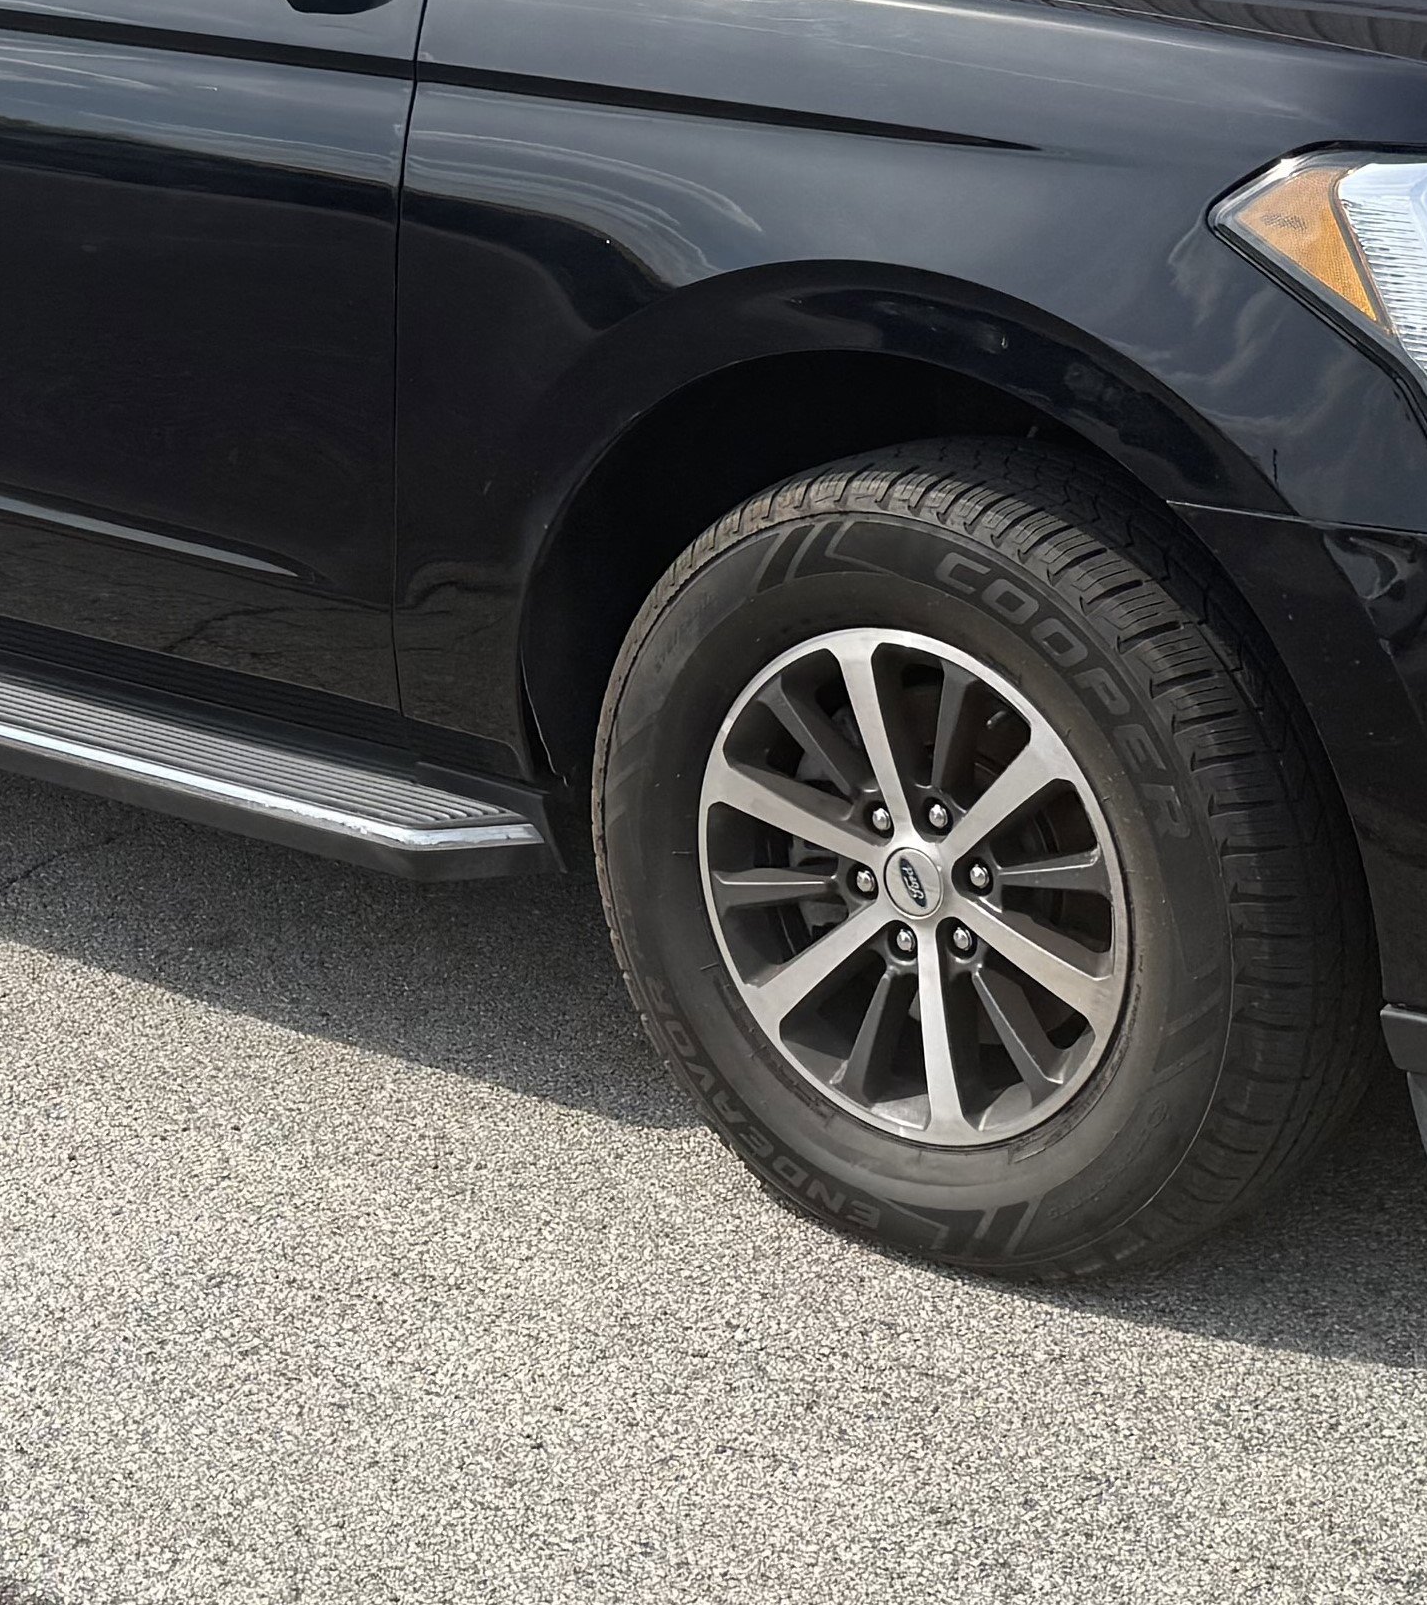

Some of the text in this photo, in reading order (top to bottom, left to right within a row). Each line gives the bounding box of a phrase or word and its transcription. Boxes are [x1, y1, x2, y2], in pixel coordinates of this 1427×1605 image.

[934, 552, 1190, 838] COOPER
[902, 866, 925, 899] Ford
[645, 976, 881, 1230] ENDEAVOR
